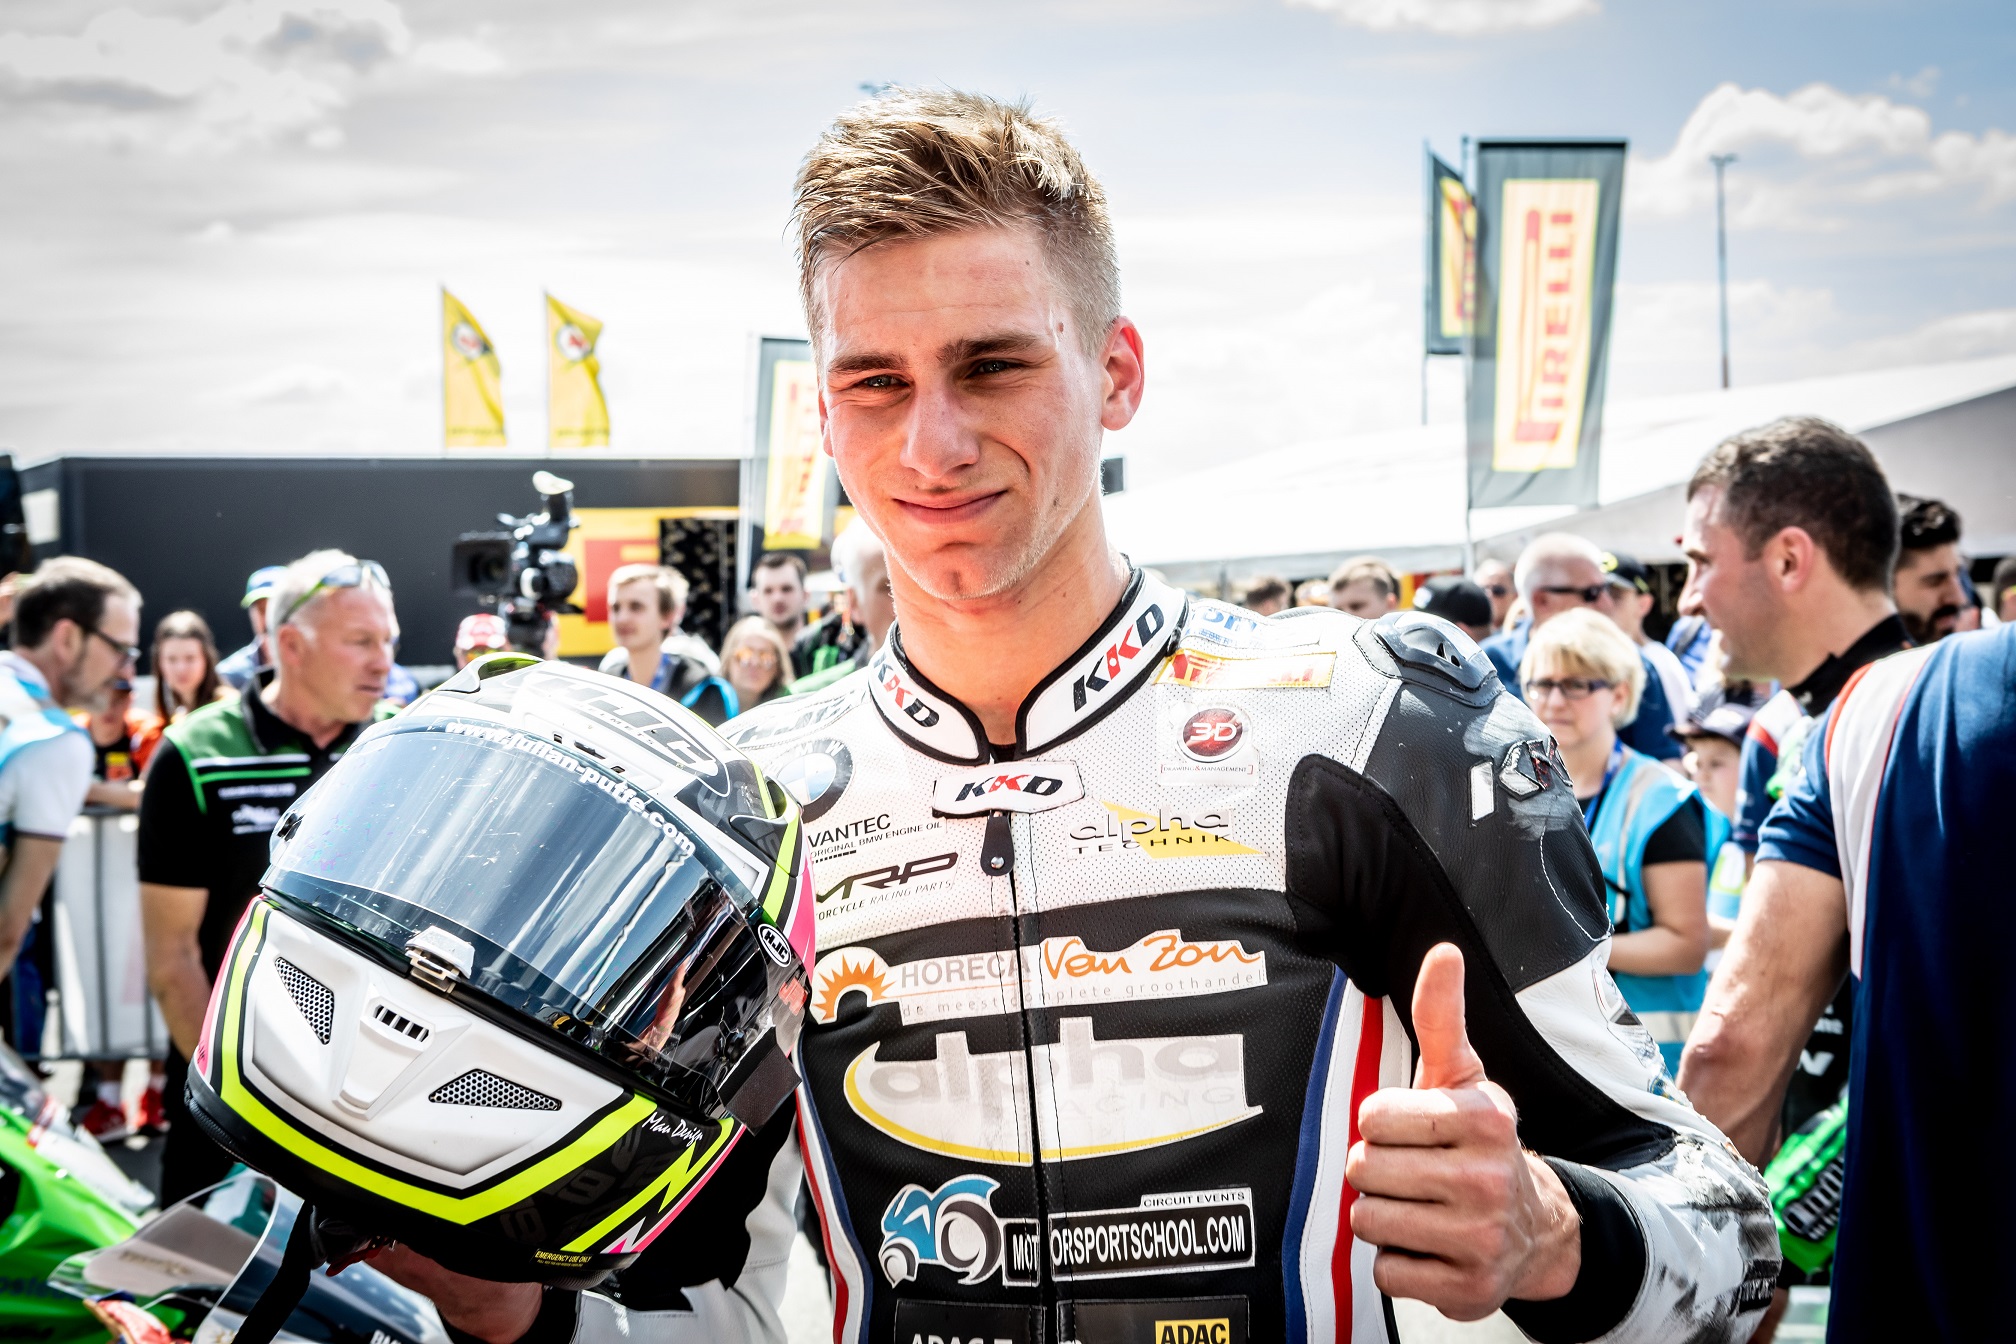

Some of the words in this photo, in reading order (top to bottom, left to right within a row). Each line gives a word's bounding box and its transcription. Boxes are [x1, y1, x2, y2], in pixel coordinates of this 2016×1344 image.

[1512, 209, 1574, 443] PIRELLI
[1072, 603, 1165, 713] KKD
[1189, 722, 1238, 742] 3D
[954, 774, 1063, 802] KKD
[859, 833, 883, 846] BMW
[885, 824, 924, 839] ENGINE
[926, 822, 943, 831] OIL
[1069, 804, 1230, 843] alpha
[1071, 833, 1231, 855] TECHNIK
[816, 899, 866, 921] ORCYCLE
[870, 886, 912, 906] RACING
[915, 880, 952, 894] PARTS
[764, 930, 788, 960] HJC
[901, 951, 1031, 989] HORECA
[1044, 939, 1132, 980] Van
[1143, 934, 1261, 972] Zon
[902, 1005, 925, 1018] de
[937, 998, 999, 1013] meest
[1126, 969, 1264, 997] groothandel
[869, 1021, 1242, 1121] alpha
[671, 1118, 704, 1148] Design
[1143, 1196, 1194, 1208] CIRCUIT
[1197, 1191, 1246, 1204] EVENTS
[534, 1250, 571, 1262] EMERGENCY
[568, 1255, 580, 1263] USE
[578, 1255, 593, 1263] ONLY
[1161, 1323, 1227, 1344] ADAC
